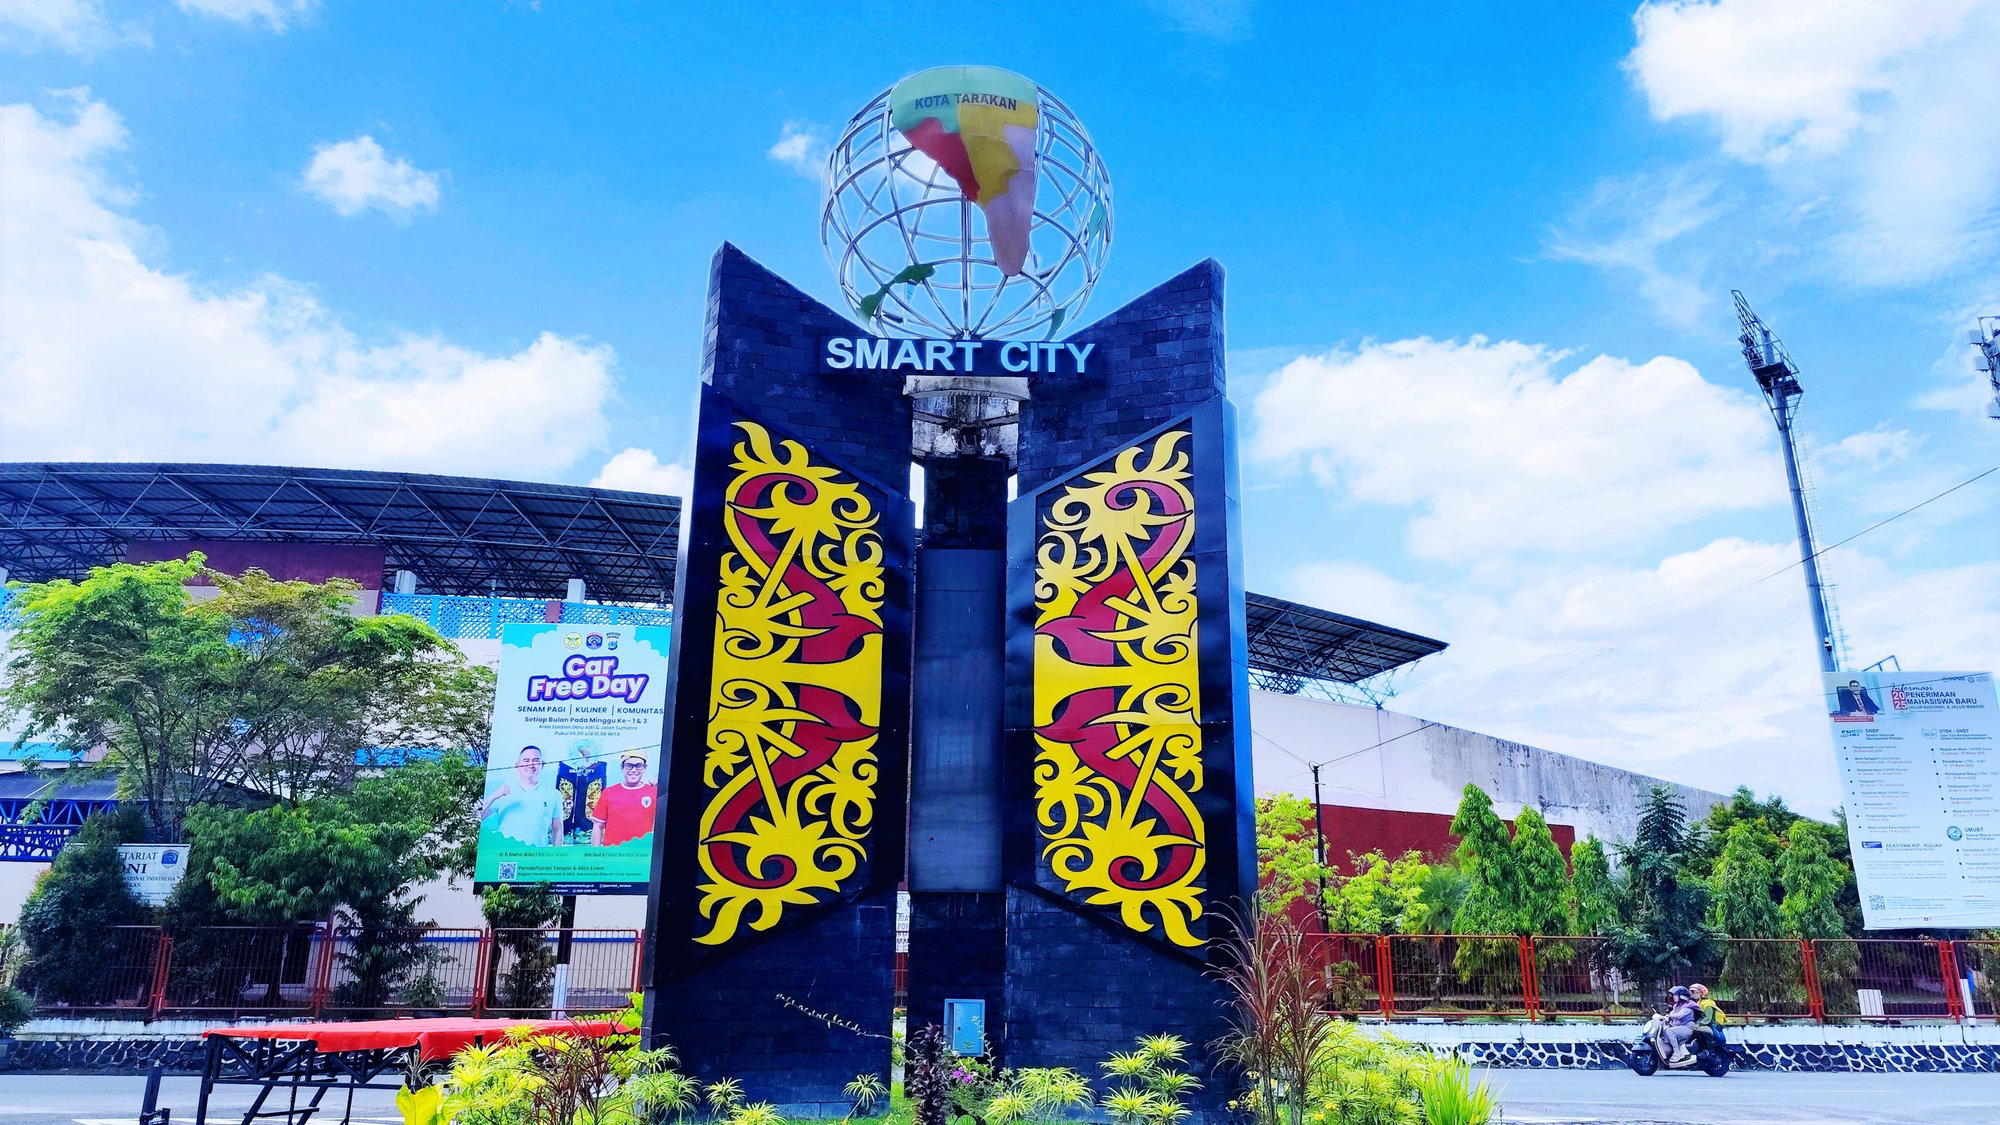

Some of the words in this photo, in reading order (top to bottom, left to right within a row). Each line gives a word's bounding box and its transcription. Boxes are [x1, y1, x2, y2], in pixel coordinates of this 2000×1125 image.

[914, 94, 950, 110] KOTA
[954, 93, 1017, 111] TARAKAN
[826, 337, 982, 372] SMART
[1000, 341, 1096, 373] CITY
[564, 655, 617, 678] Car
[529, 677, 588, 701] Free
[590, 675, 649, 702] Day
[517, 705, 546, 713] SENAM
[546, 705, 566, 713] PAGI
[575, 706, 608, 714] KULINER
[617, 707, 664, 715] KOMUNITAS
[589, 717, 616, 725] Minggu
[117, 851, 159, 861] ETARIAT
